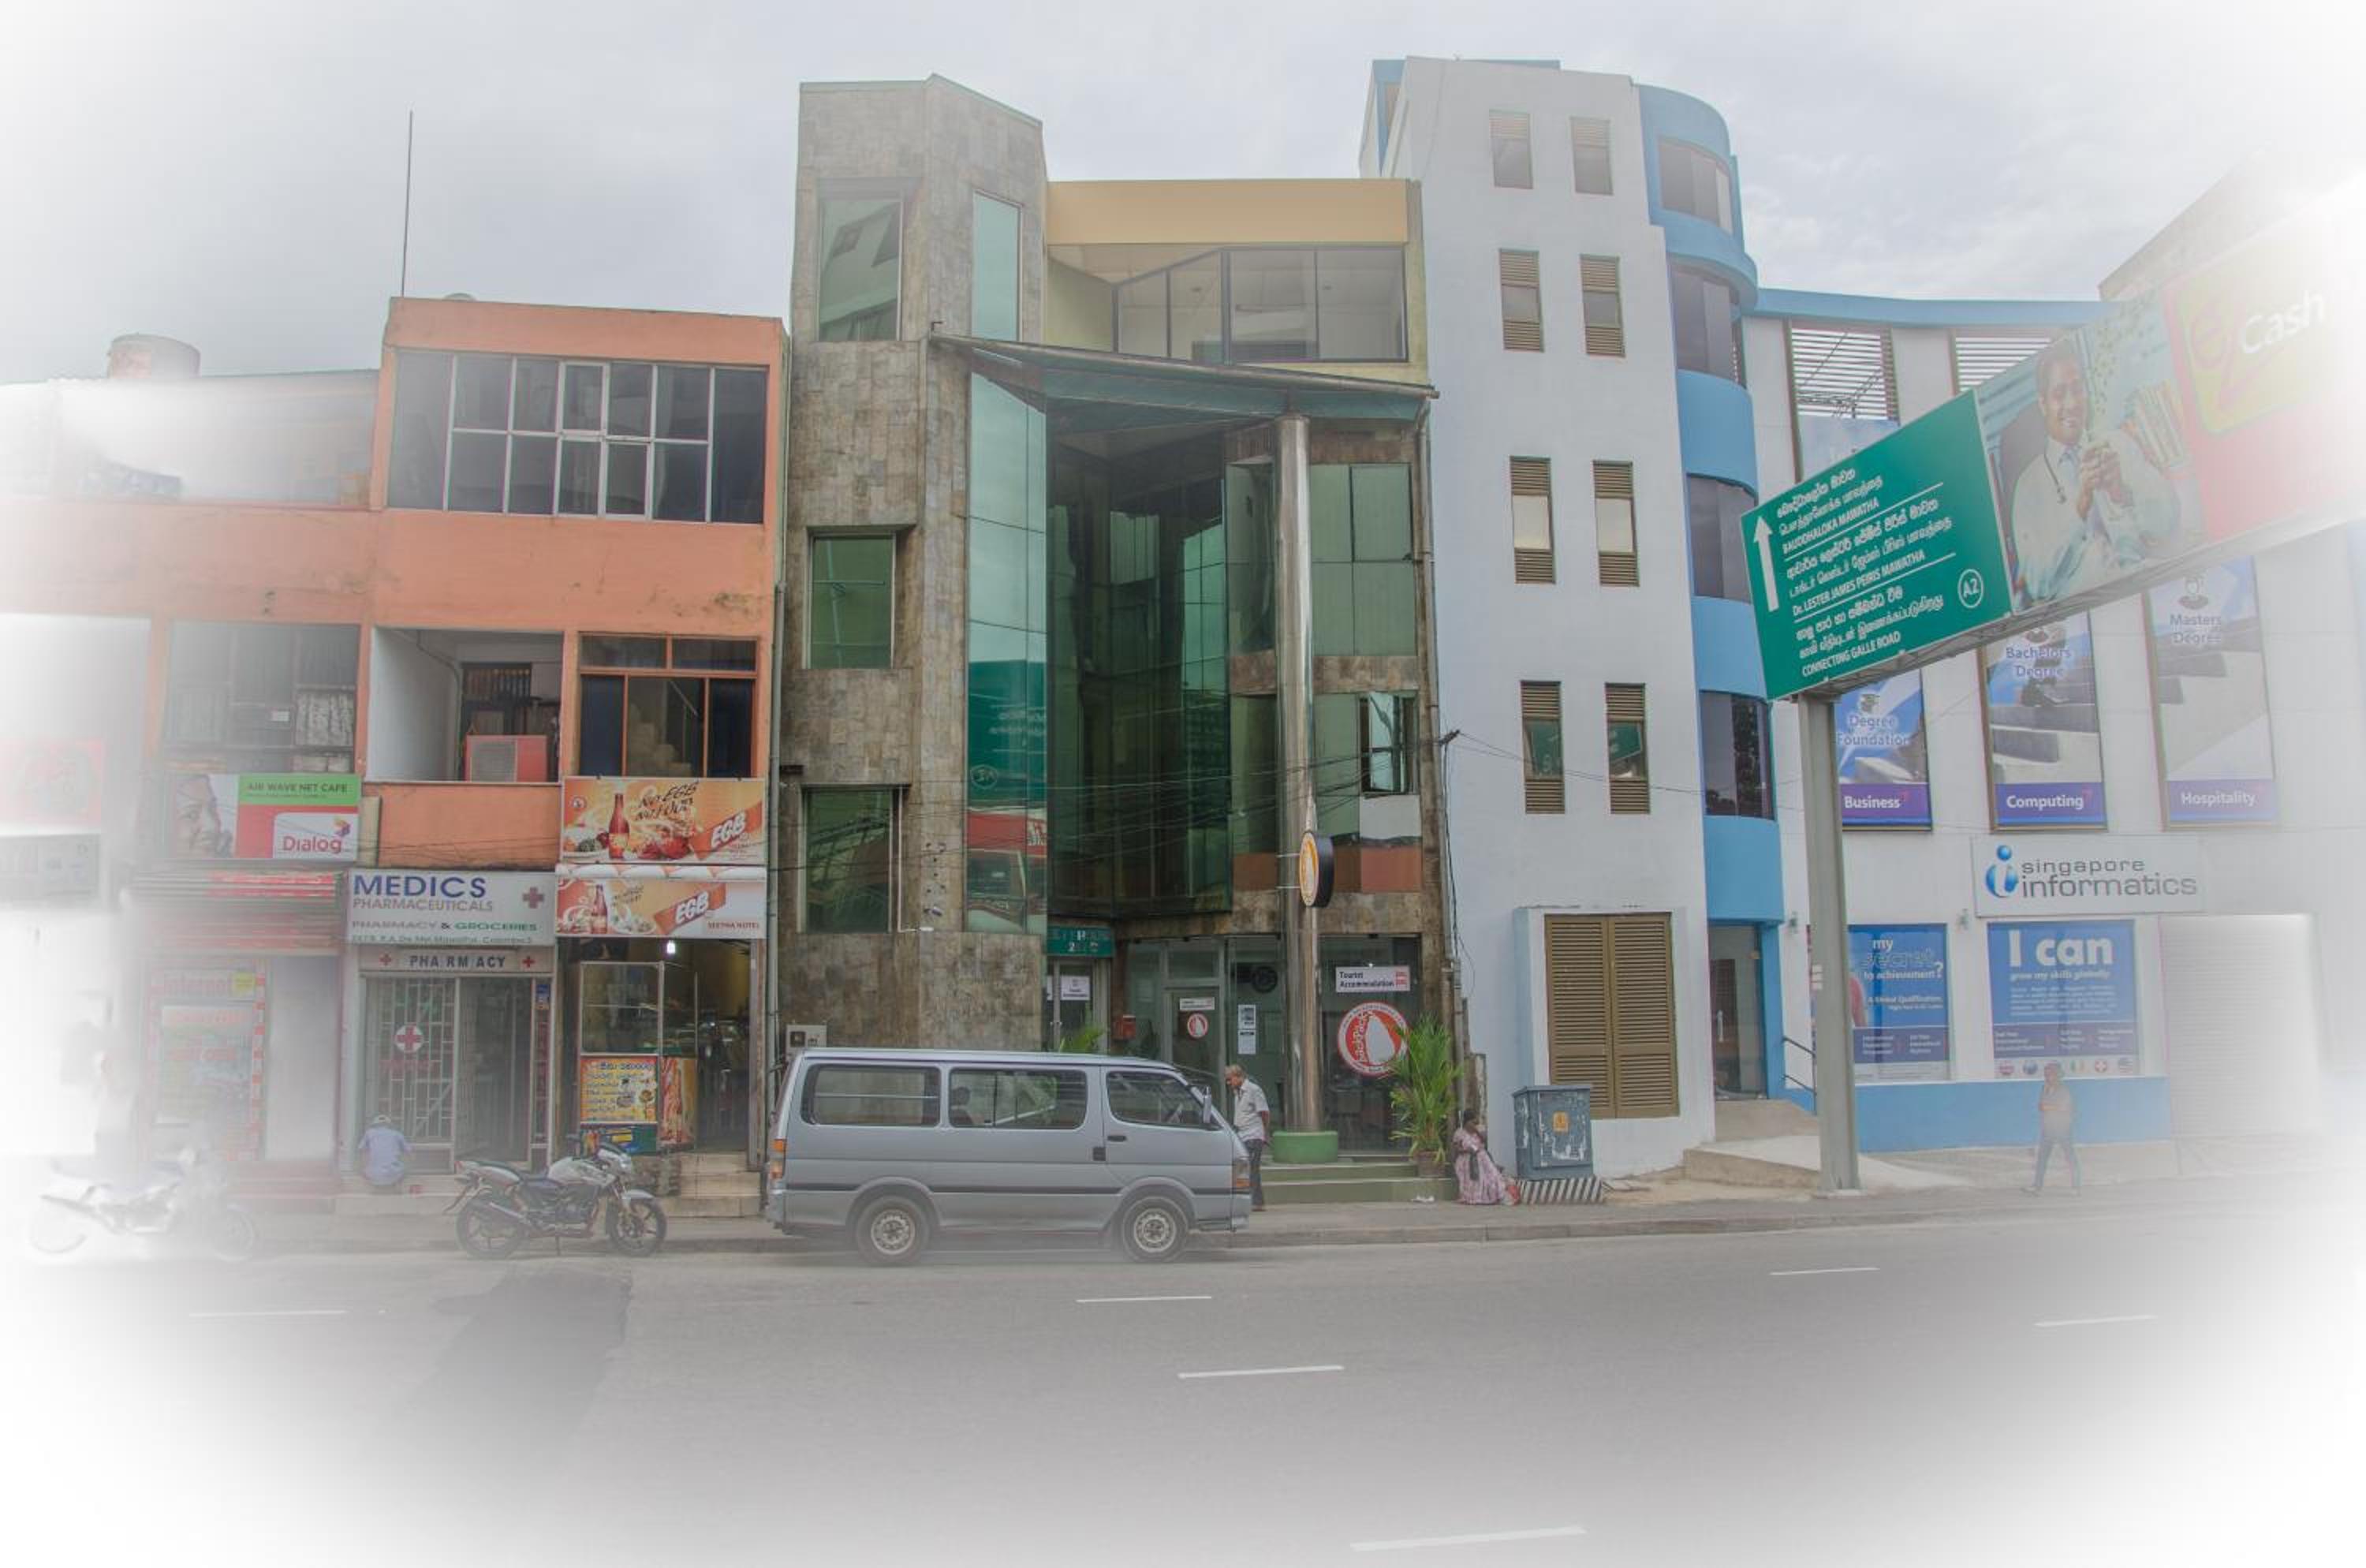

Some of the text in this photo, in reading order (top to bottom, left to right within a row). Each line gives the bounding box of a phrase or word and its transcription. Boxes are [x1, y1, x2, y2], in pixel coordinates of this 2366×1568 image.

[2242, 290, 2325, 353] Cash
[1838, 498, 1879, 525] MAWATHA
[1804, 591, 1830, 610] LESTER
[1831, 580, 1856, 599] JAMES
[1882, 551, 1925, 576] MAWATHA
[1961, 577, 1980, 597] A2
[2170, 613, 2221, 626] Masters
[2173, 633, 2221, 645] Degree
[1802, 631, 1901, 675] CONNECTING GALLE ROAD
[2006, 647, 2071, 659] Bachelors
[2015, 665, 2064, 679] Degree
[1849, 715, 1894, 730] Degree
[1837, 732, 1909, 746] Foundation
[300, 783, 318, 792] NET
[321, 783, 348, 793] CAFE
[1844, 795, 1901, 808] Business
[2006, 794, 2085, 811] Computing
[2180, 791, 2256, 808] Hospitality
[282, 834, 342, 854] Dialog
[2021, 858, 2146, 876] singapore
[353, 875, 487, 898] MEDICS
[2022, 872, 2196, 898] informatics
[353, 898, 493, 912] PHARMACEUTICALS
[675, 891, 710, 924] EGB
[353, 920, 437, 930] PHARMACY
[453, 922, 537, 931] GROCERIES
[1872, 939, 1894, 953] my
[2009, 929, 2114, 967] I can
